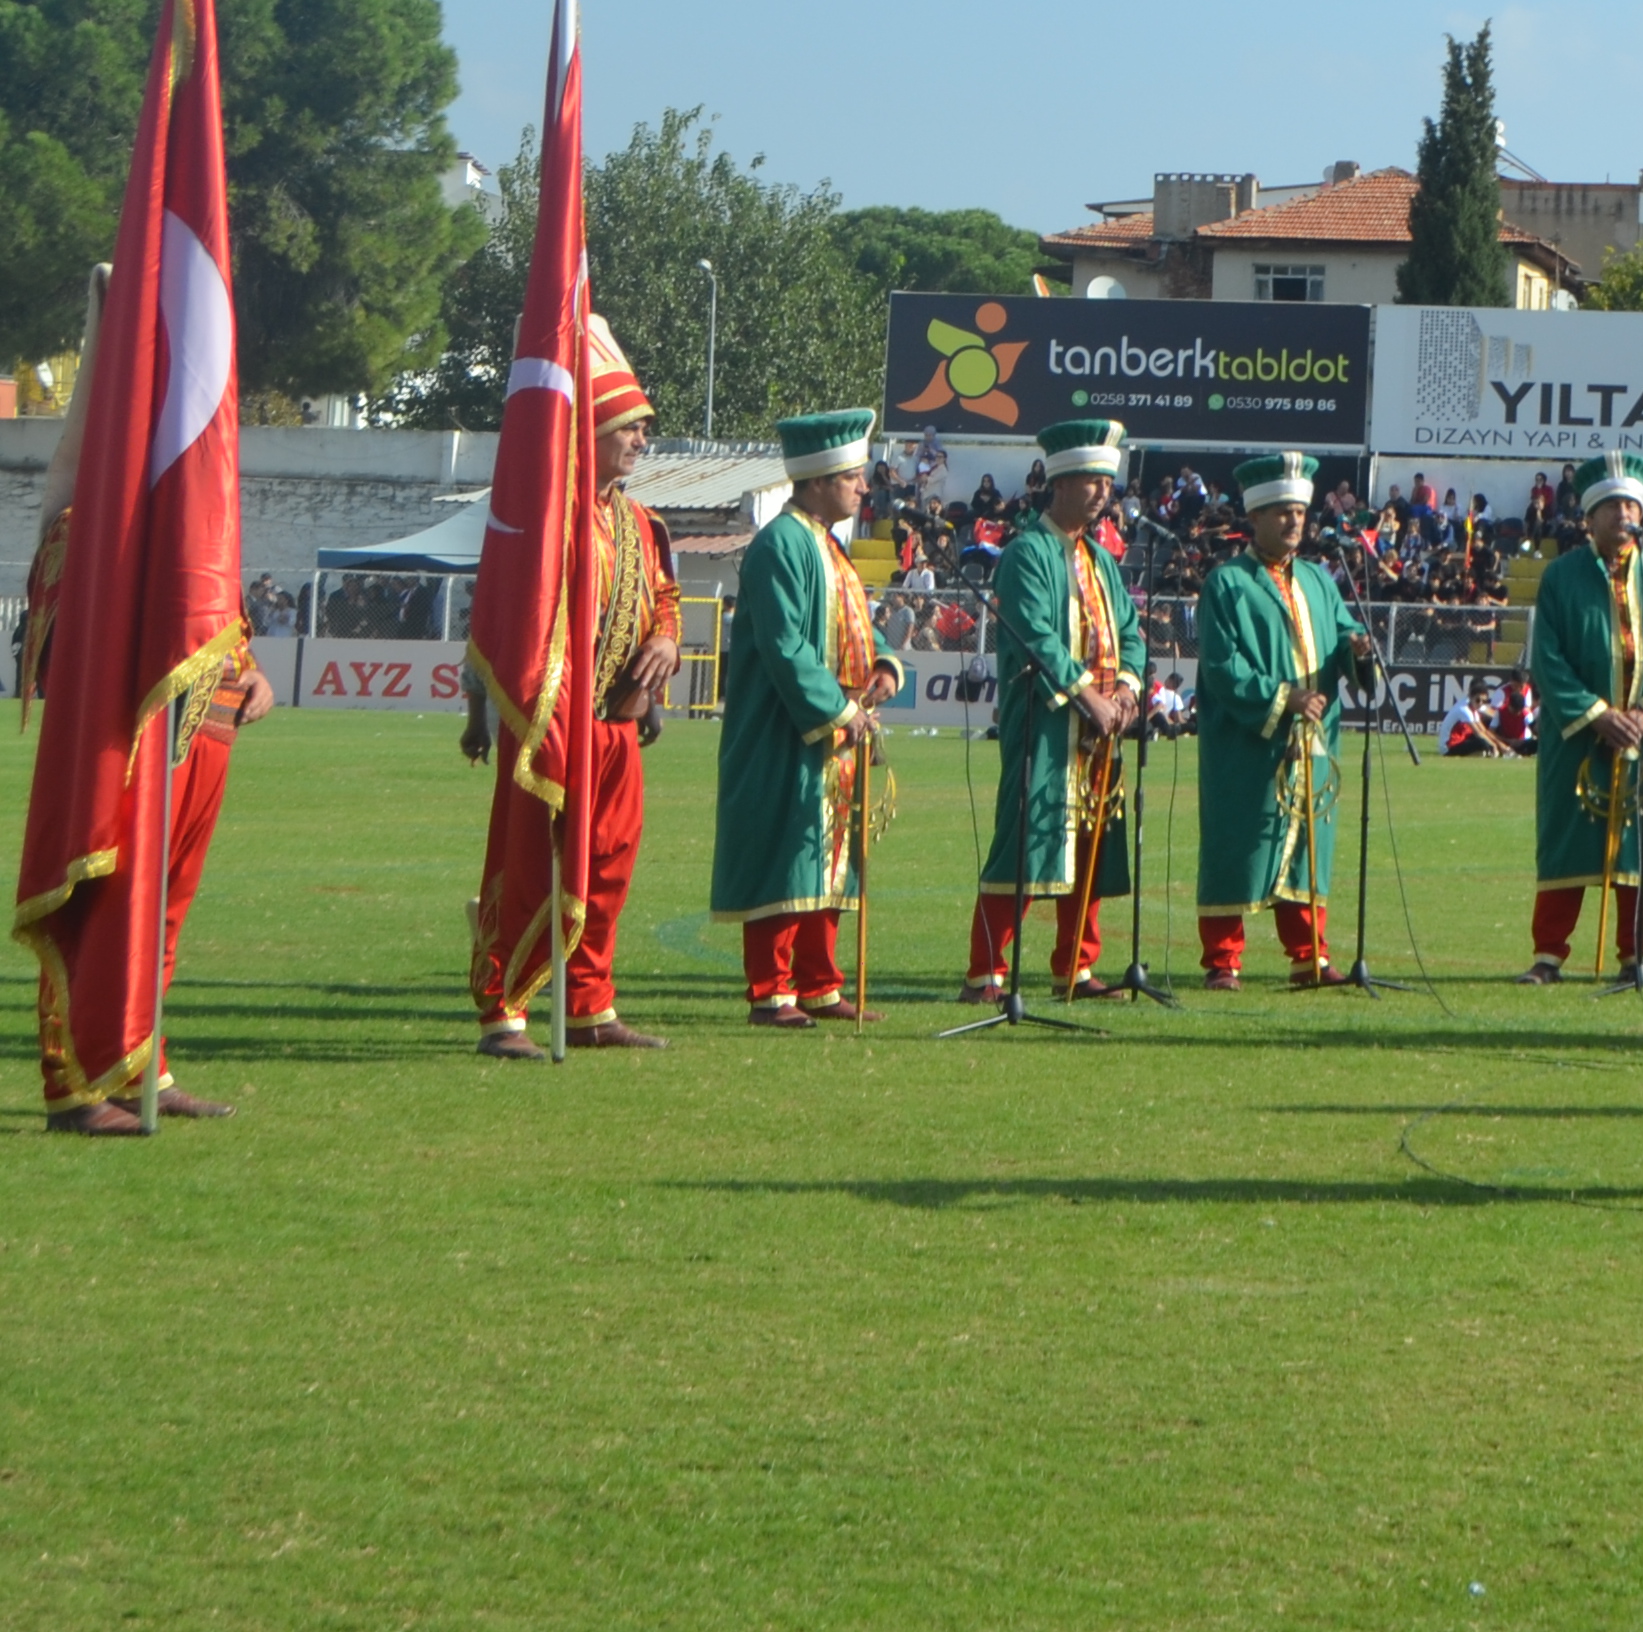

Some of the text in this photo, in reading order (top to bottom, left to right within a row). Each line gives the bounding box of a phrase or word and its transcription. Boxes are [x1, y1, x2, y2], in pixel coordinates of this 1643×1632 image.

[1090, 392, 1193, 408] 0258 371 41 89
[1226, 396, 1337, 411] 0530 975 89 86
[1415, 425, 1513, 446] DİZAYN
[1523, 430, 1577, 449] YAPI
[1587, 433, 1605, 450] &
[312, 661, 412, 698] AYZ
